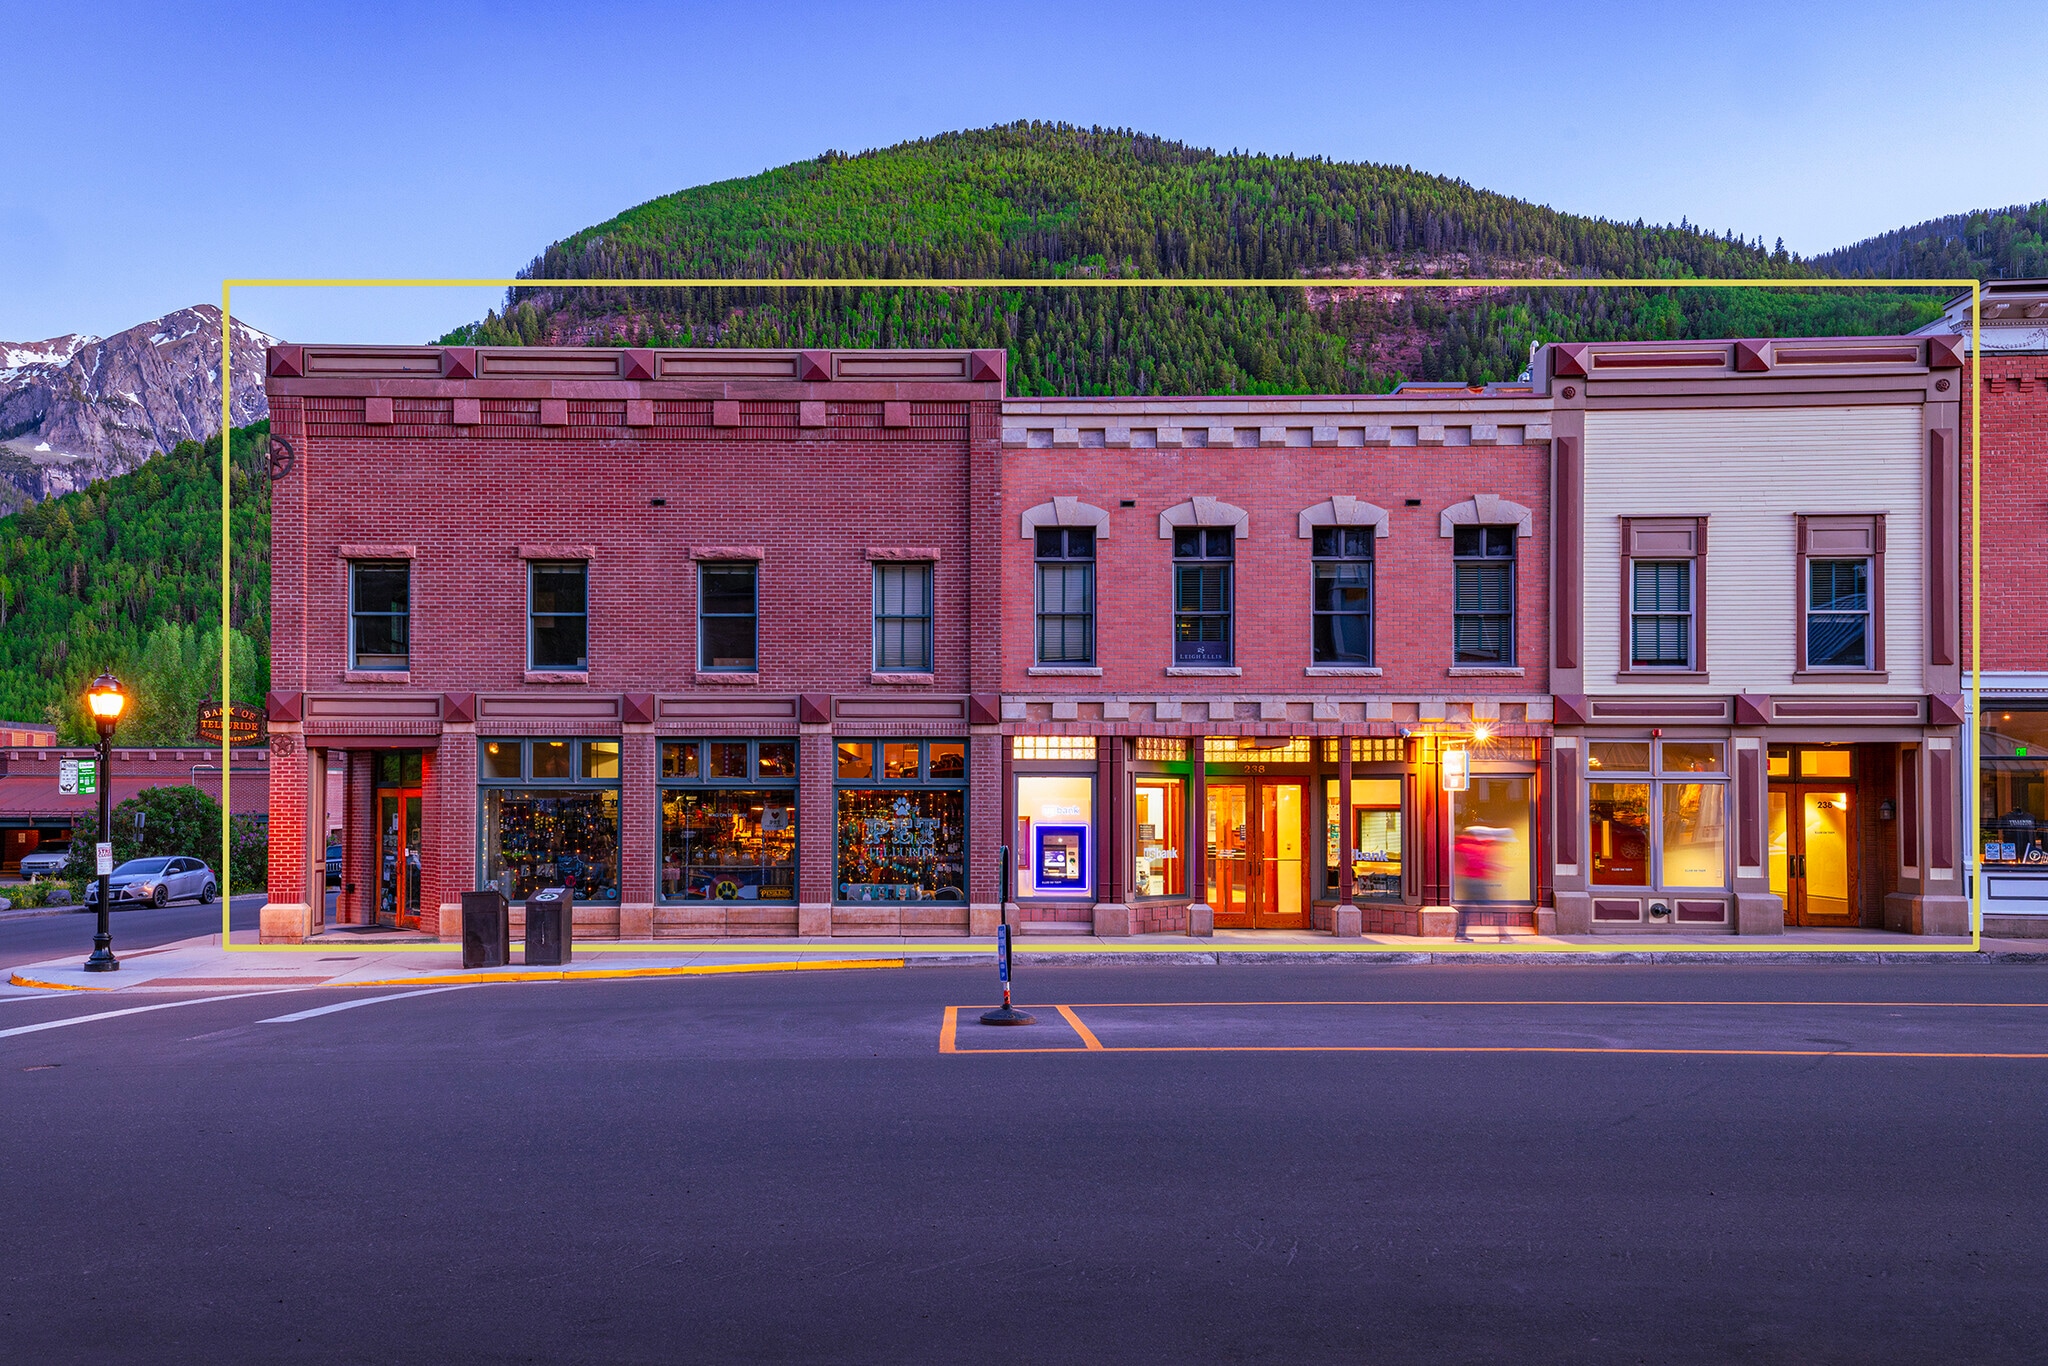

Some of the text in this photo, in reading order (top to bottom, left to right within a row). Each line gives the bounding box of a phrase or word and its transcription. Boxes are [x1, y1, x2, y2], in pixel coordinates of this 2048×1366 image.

[241, 709, 256, 721] OF
[200, 720, 258, 731] TELURIDE
[1244, 765, 1265, 774] 238
[1817, 801, 1833, 809] 238
[864, 817, 941, 845] PET
